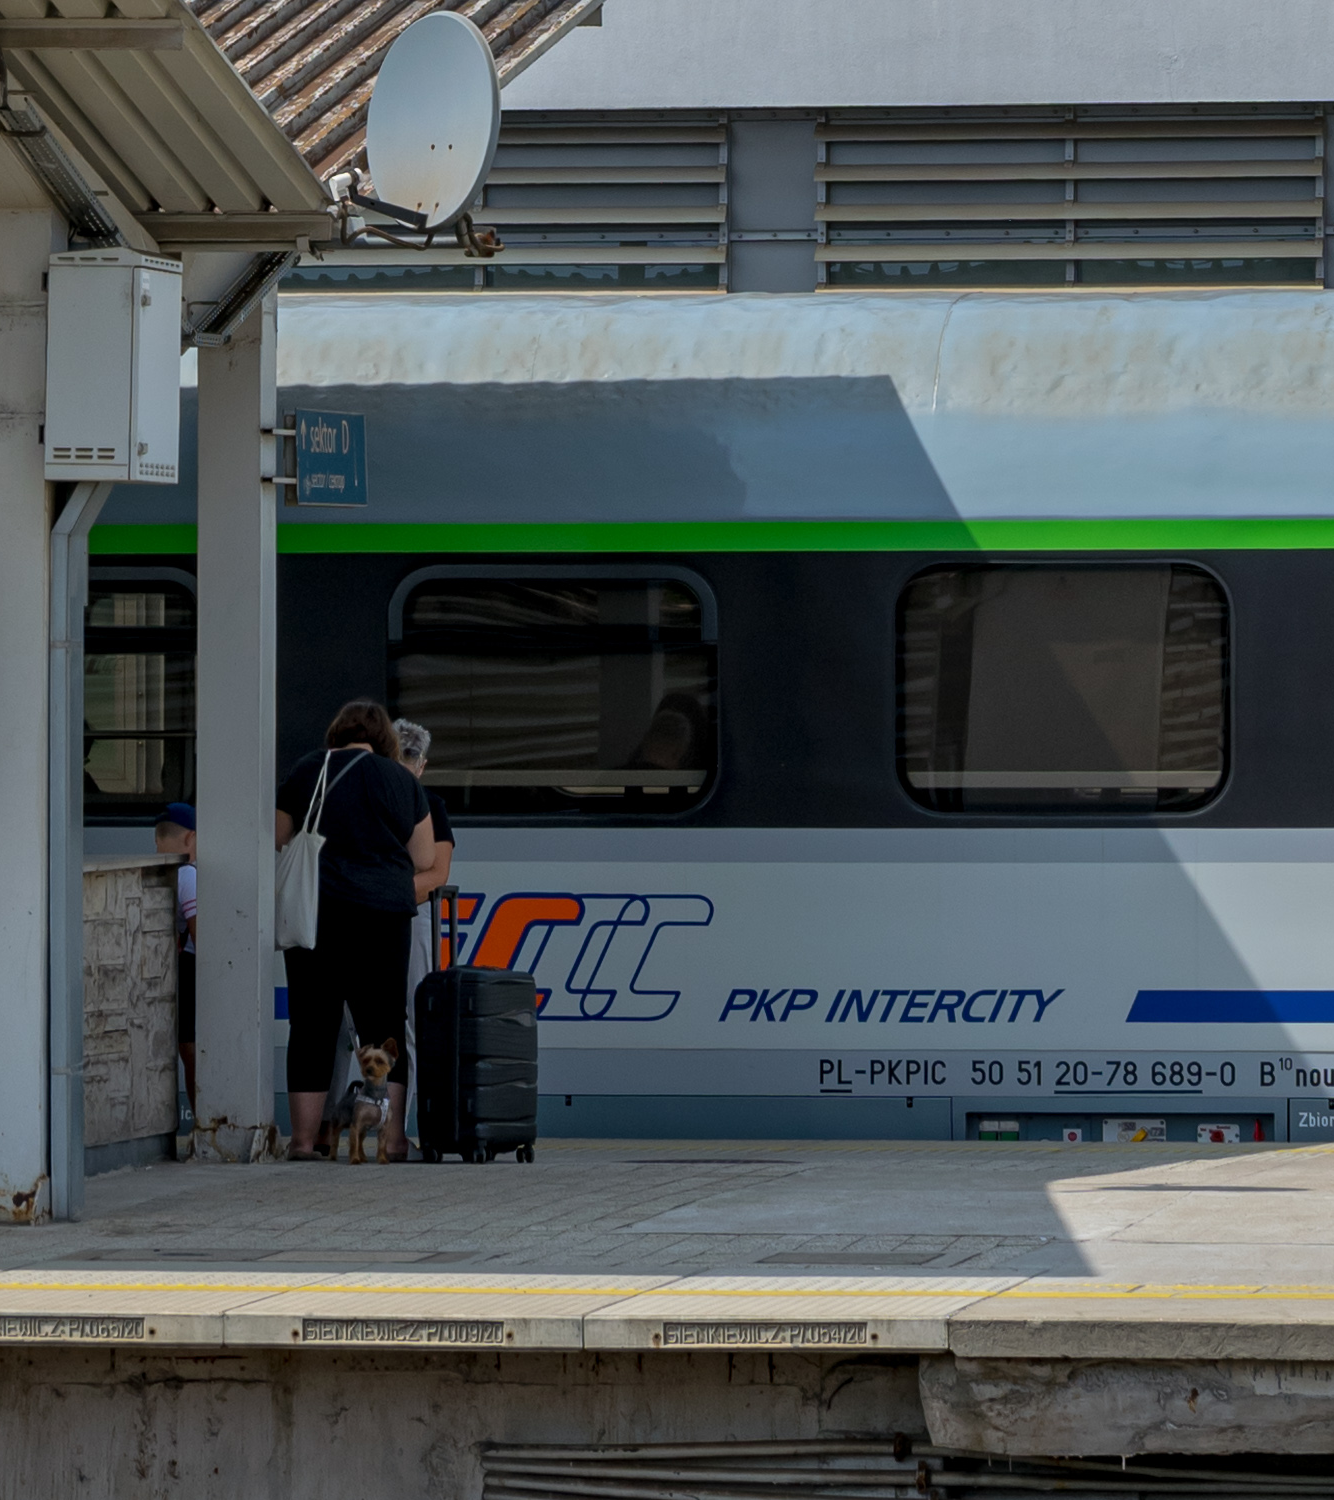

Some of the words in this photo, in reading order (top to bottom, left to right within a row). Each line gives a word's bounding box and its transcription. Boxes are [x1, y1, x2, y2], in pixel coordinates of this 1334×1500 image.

[310, 416, 337, 453] sektor
[342, 420, 349, 454] D
[718, 989, 818, 1023] PKP
[824, 989, 1065, 1023] INTERCITY
[819, 1058, 947, 1086] PL-PKPIC
[970, 1060, 1004, 1086] 50
[1017, 1060, 1042, 1086] 51
[1055, 1060, 1138, 1087] 20-78
[1151, 1060, 1236, 1087] 689-0
